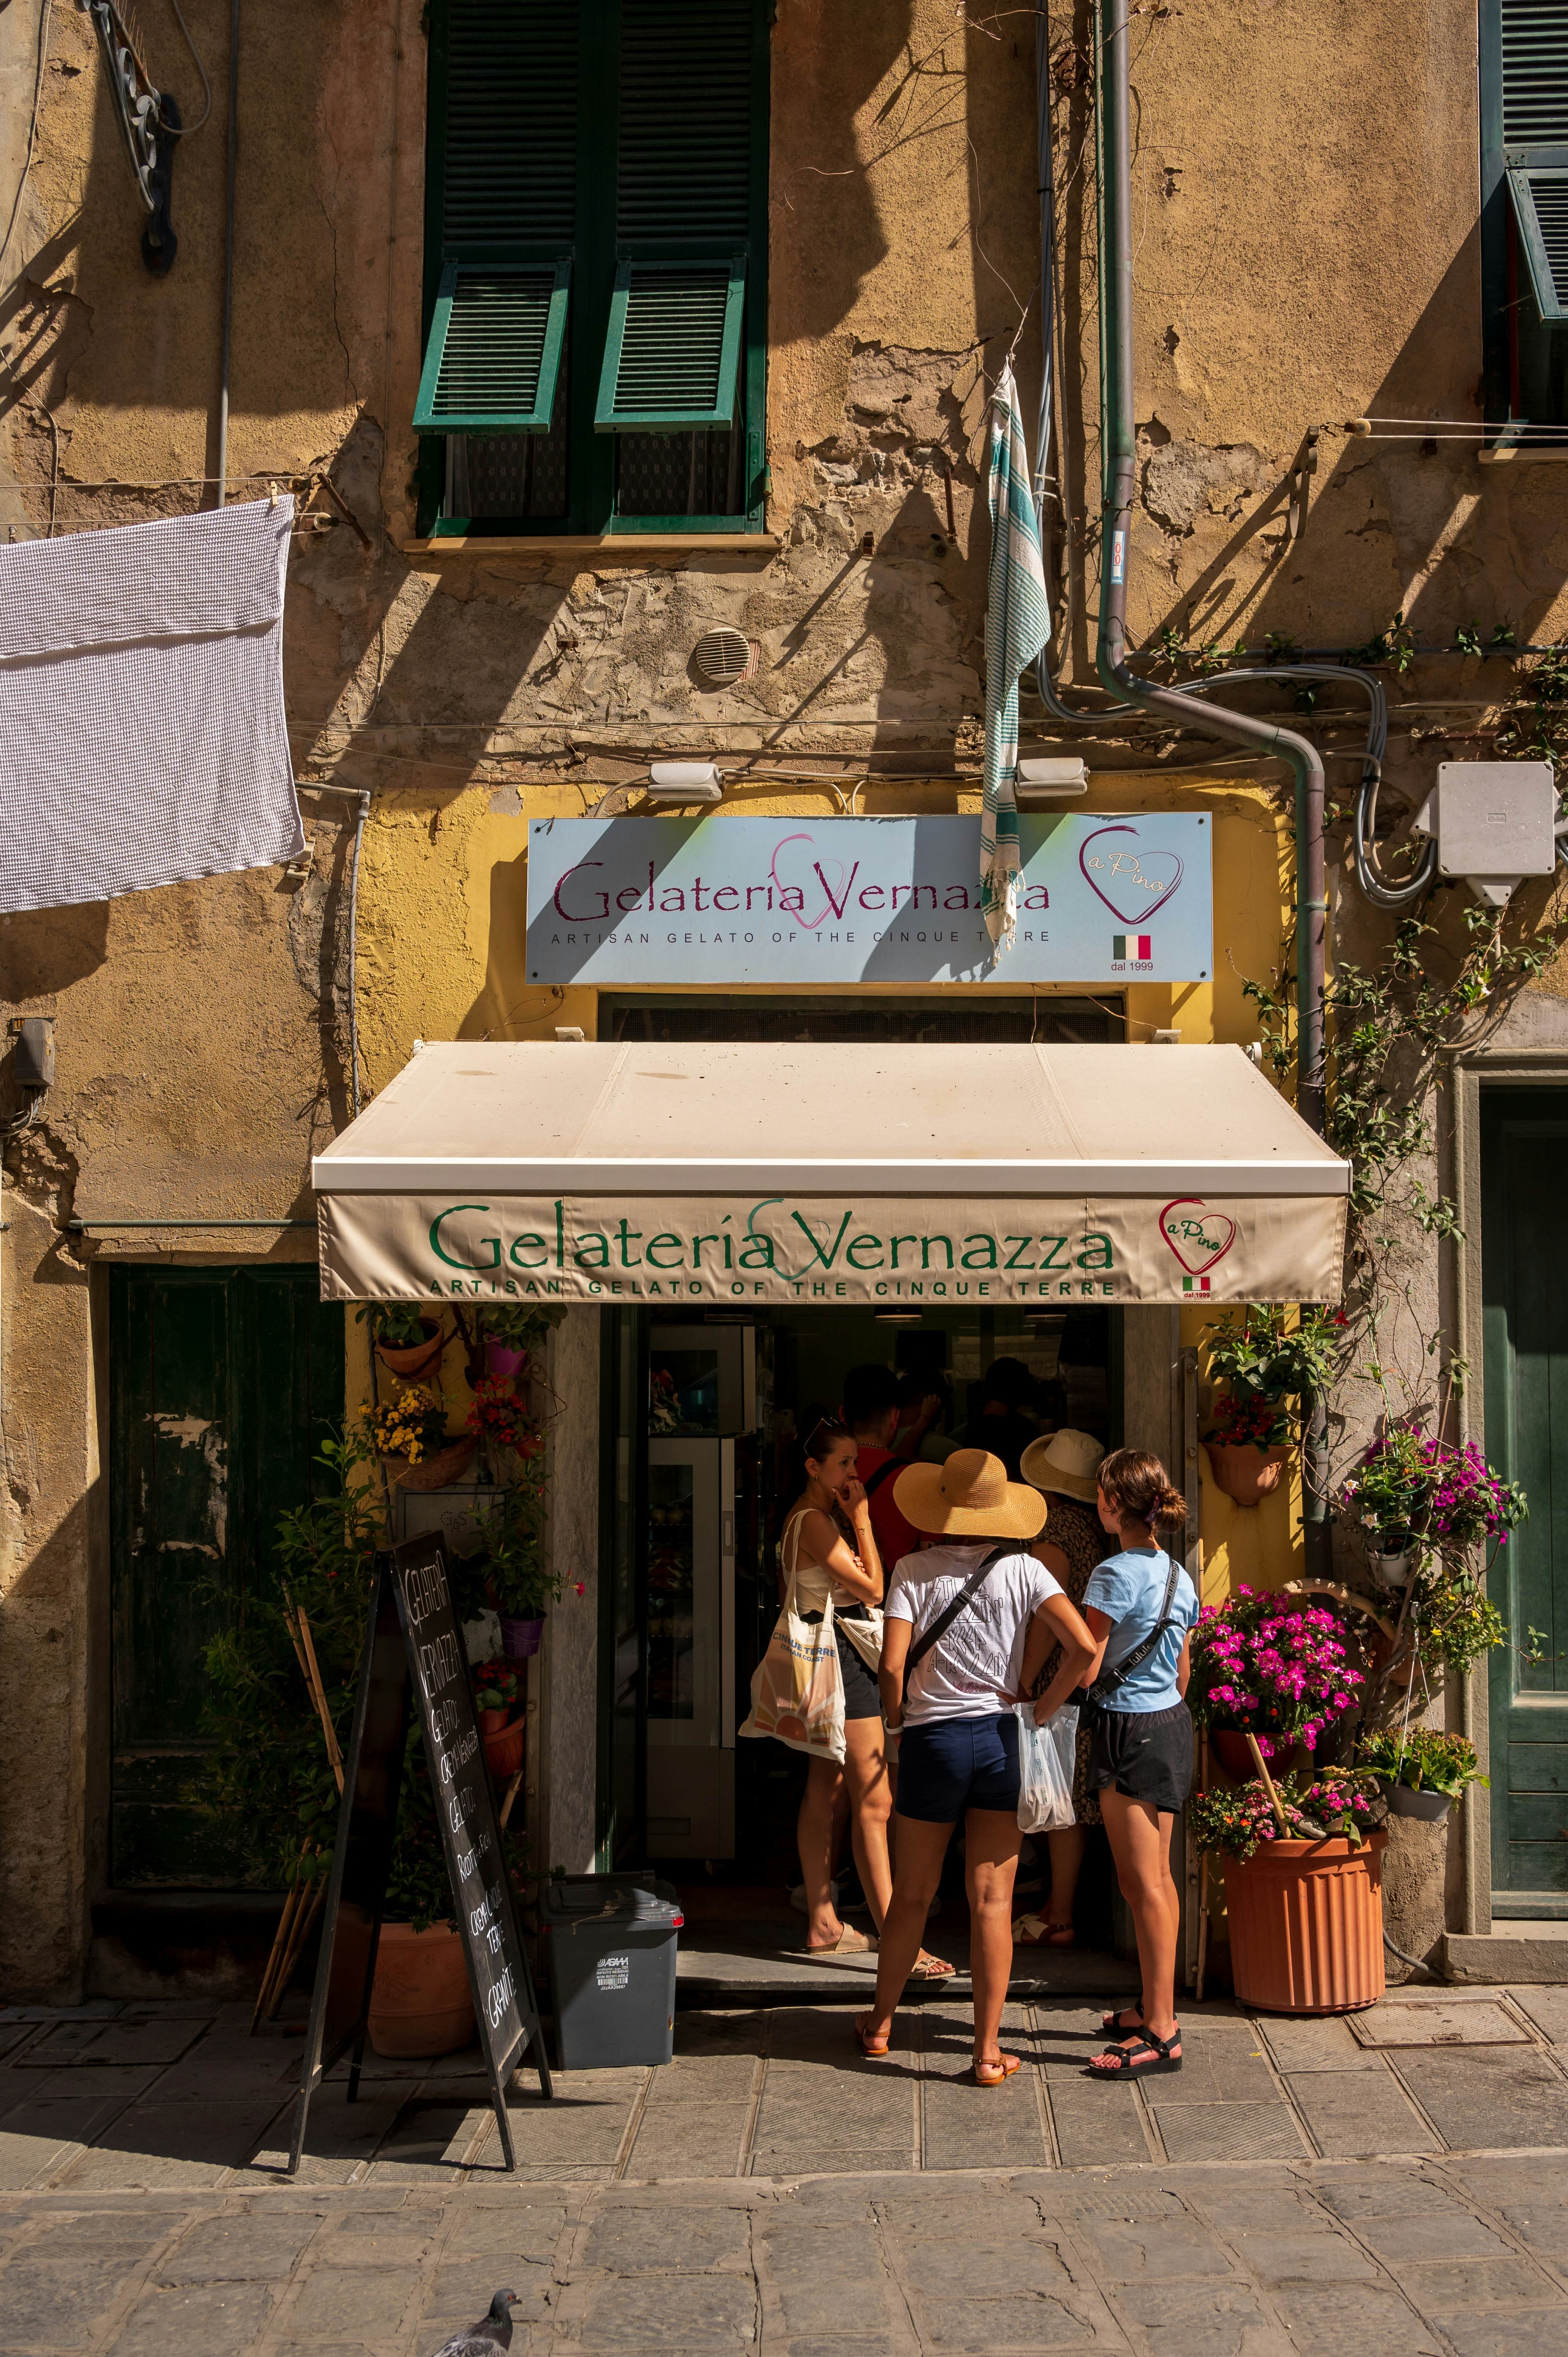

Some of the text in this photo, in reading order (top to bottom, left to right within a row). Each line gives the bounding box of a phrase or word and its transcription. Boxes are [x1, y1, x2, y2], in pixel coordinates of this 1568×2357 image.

[1088, 852, 1167, 892] a Pino
[813, 860, 1050, 920] Vernaa
[551, 931, 1049, 944] ARTISAN GELATO OF THE CINQUE TRE
[1111, 962, 1153, 971] dal 1999
[783, 1210, 1114, 1270] Vernazza
[1167, 1220, 1220, 1251] a Pino
[430, 1279, 1114, 1296] ARTISAN GELATO OF THE CINQUE TERRE
[440, 1511, 466, 1532] GAS
[804, 1647, 835, 1657] TERRE
[948, 1626, 987, 1654] KEEP
[420, 1629, 463, 1699] VERNAZZA
[431, 1699, 460, 1746] GELATO:
[441, 1725, 479, 1784] CREMA VERNAZZA
[450, 1786, 475, 1834] GELATO:
[471, 1902, 489, 1936] CREMA
[487, 1920, 505, 1954] TERRE
